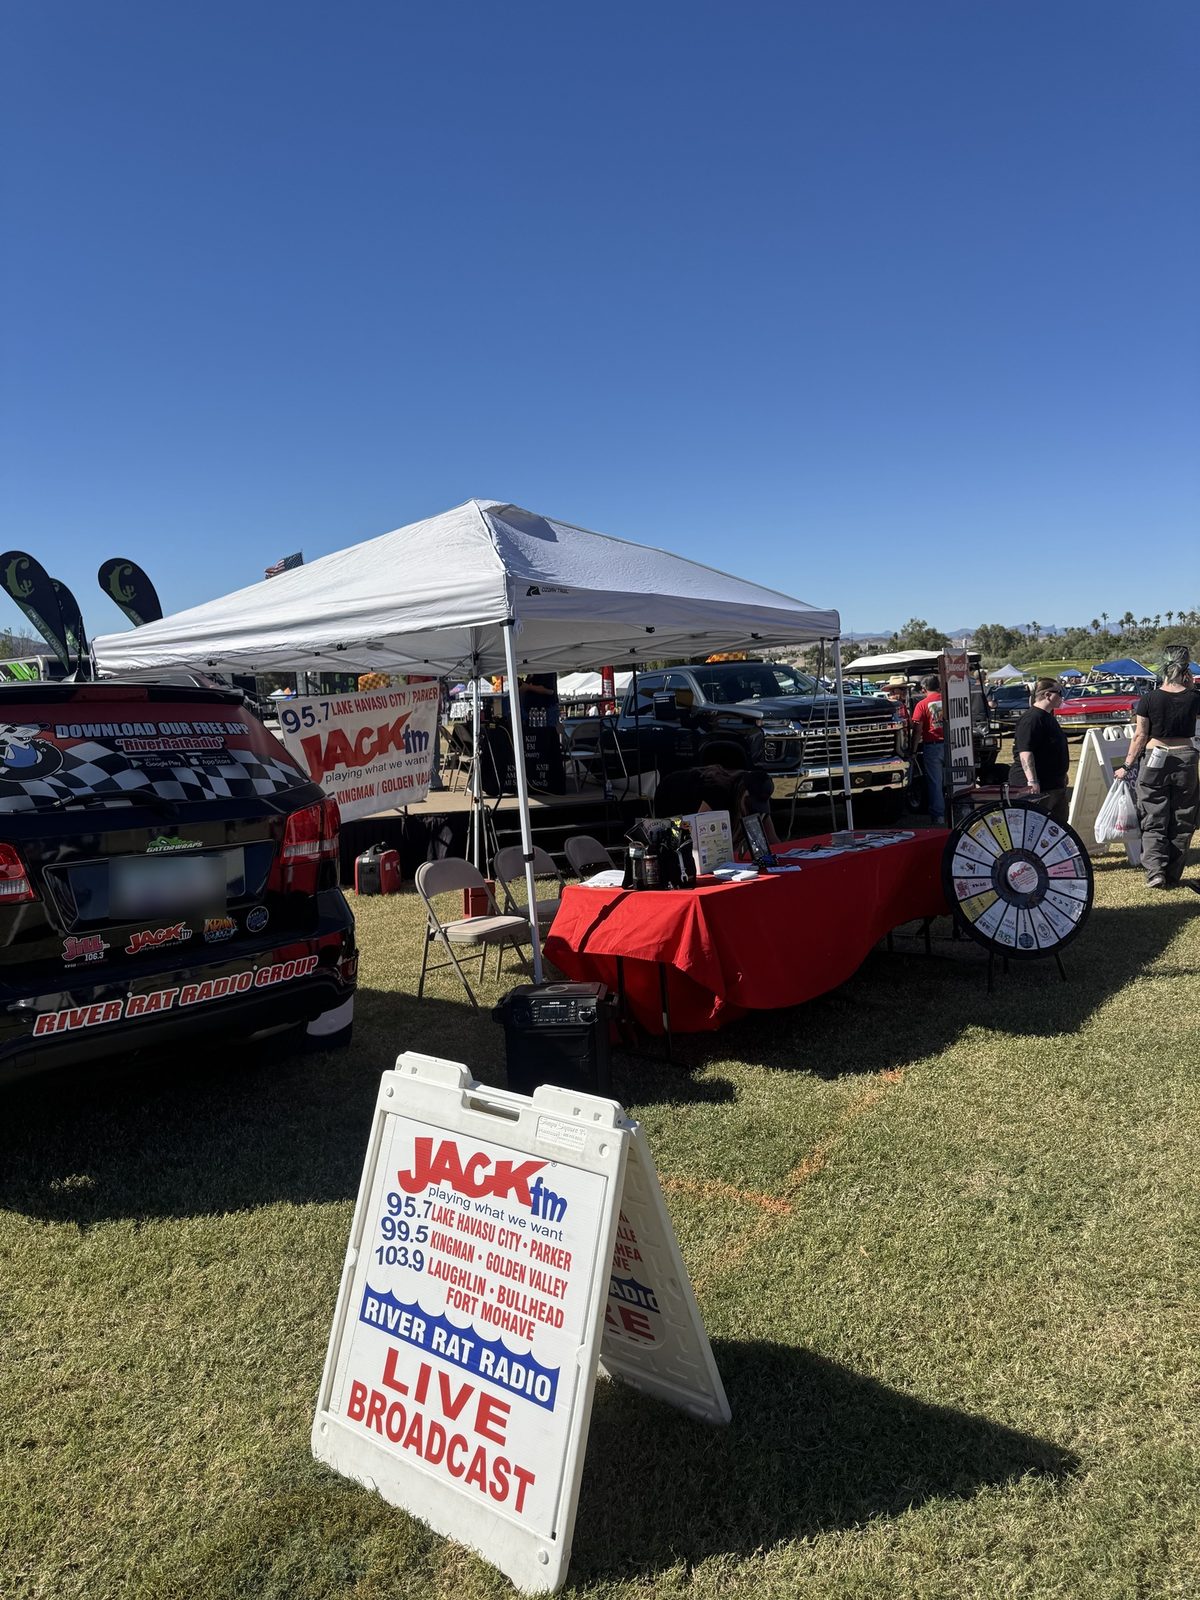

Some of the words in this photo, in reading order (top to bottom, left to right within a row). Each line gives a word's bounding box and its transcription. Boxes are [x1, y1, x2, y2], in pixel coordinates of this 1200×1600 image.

[55, 723, 158, 739] DOWNLOAD
[158, 722, 192, 736] OUR
[193, 722, 227, 735] FREE
[227, 722, 249, 735] APP
[281, 701, 329, 734] 95.7
[331, 700, 354, 716] LAKE
[355, 696, 388, 713] HAVASU
[389, 692, 406, 707] CITY
[412, 686, 439, 703] PARKER
[300, 710, 413, 785] JACK
[403, 724, 429, 755] fm
[325, 769, 363, 784] playing
[365, 763, 387, 775] what
[389, 760, 402, 769] we
[404, 756, 428, 766] want
[336, 787, 375, 805] KINGMAN
[381, 776, 414, 793] GOLDEN
[85, 952, 104, 962] 106.3
[125, 922, 186, 954] JACK
[33, 1000, 122, 1036] RIVER
[125, 989, 178, 1018] RAT
[179, 972, 253, 1005] RADIO
[255, 955, 319, 987] GROUP
[398, 1137, 550, 1207] JACK
[530, 1177, 567, 1222] fm
[429, 1187, 471, 1211] playing
[475, 1201, 505, 1221] what
[509, 1214, 526, 1228] we
[531, 1222, 563, 1241] want
[381, 1217, 429, 1243] 99.5
[430, 1231, 475, 1263] KINGMAN
[486, 1251, 527, 1284] GOLDEN
[529, 1269, 568, 1300] VALLEY
[387, 1192, 432, 1219] 95.7
[431, 1205, 454, 1228] LAKE
[457, 1213, 495, 1242] HAVASU
[498, 1228, 522, 1252] CITY
[530, 1240, 572, 1272] PARKER
[376, 1246, 424, 1272] 103.9
[427, 1257, 487, 1293] LAUGHLIN
[497, 1285, 564, 1329] BULLHEAD
[446, 1286, 478, 1315] FORT
[480, 1310, 536, 1341] MOHAVE
[364, 1297, 426, 1343] RIVER
[431, 1326, 475, 1364] RAT
[479, 1348, 551, 1403] RADIO
[382, 1346, 511, 1447] LIVE
[347, 1379, 535, 1514] BROADCAST
